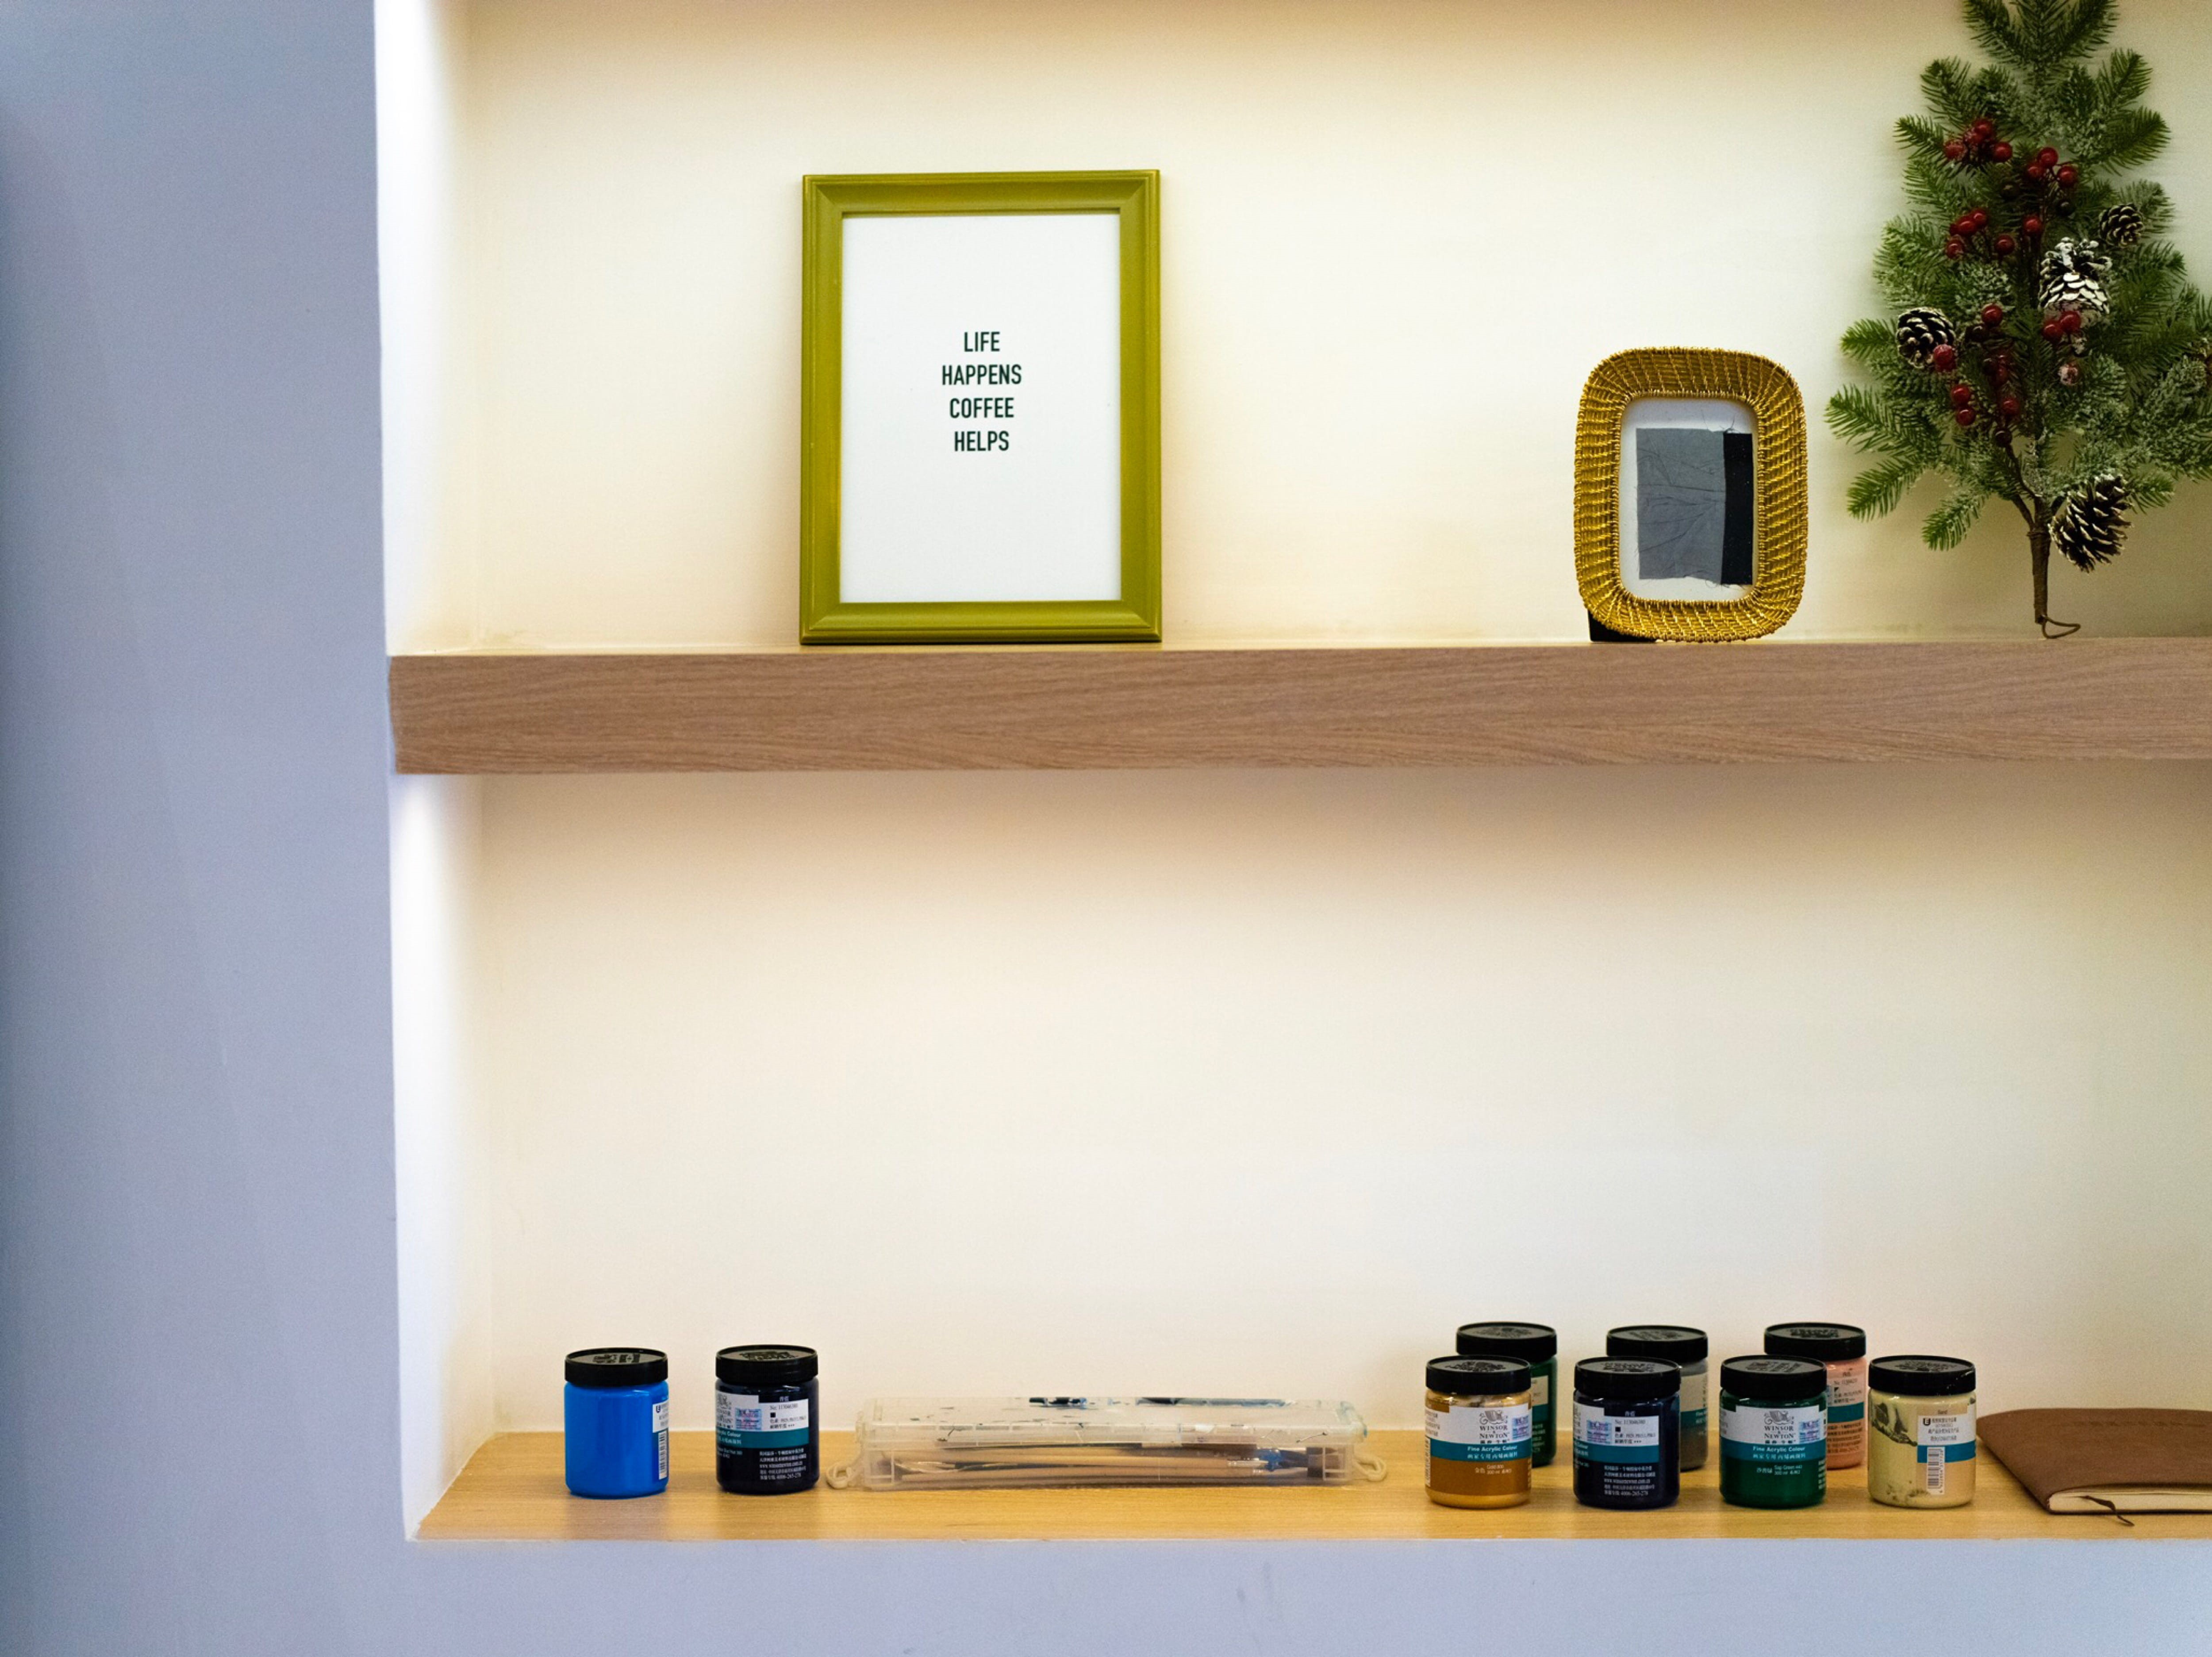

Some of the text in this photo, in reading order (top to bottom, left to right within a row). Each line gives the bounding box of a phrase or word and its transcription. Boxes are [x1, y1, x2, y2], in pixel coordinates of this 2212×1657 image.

[964, 332, 1000, 352] LIFE
[942, 364, 1022, 385] HAPPENS
[950, 397, 1014, 418] COFFEE
[954, 430, 1009, 452] HELPS
